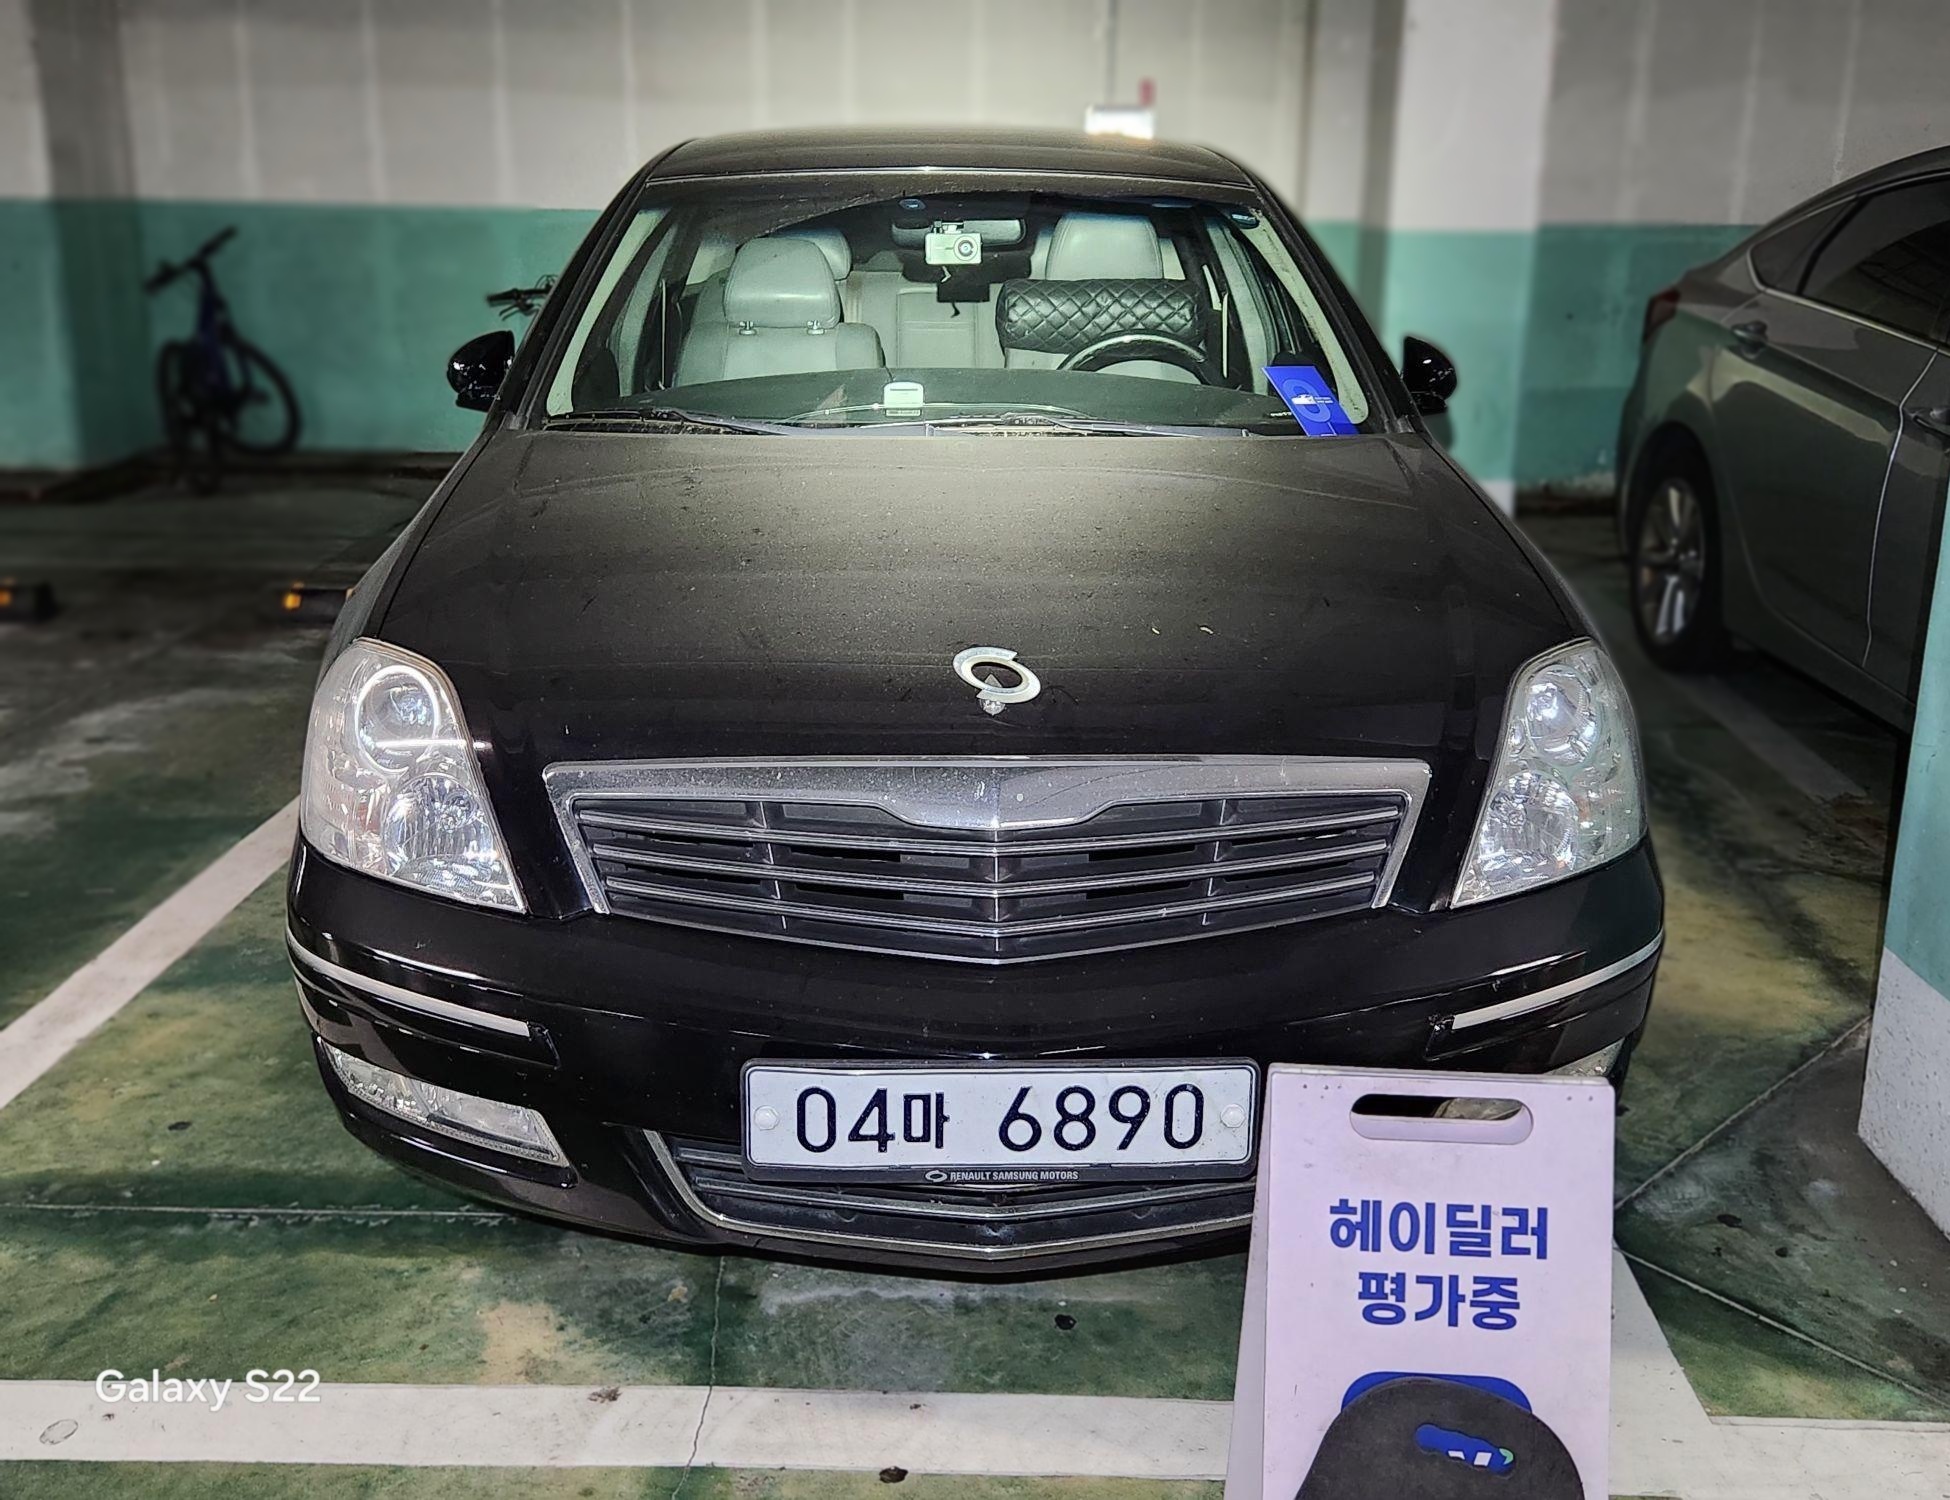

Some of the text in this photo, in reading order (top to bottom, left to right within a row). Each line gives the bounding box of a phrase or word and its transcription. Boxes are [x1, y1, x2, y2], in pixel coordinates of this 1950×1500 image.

[796, 1083, 1205, 1153] 04마 6890
[950, 1170, 1079, 1182] RENAULT SAMSUNG MOTORS
[1329, 1198, 1549, 1260] 헤이딜러
[1357, 1271, 1521, 1331] 평가중
